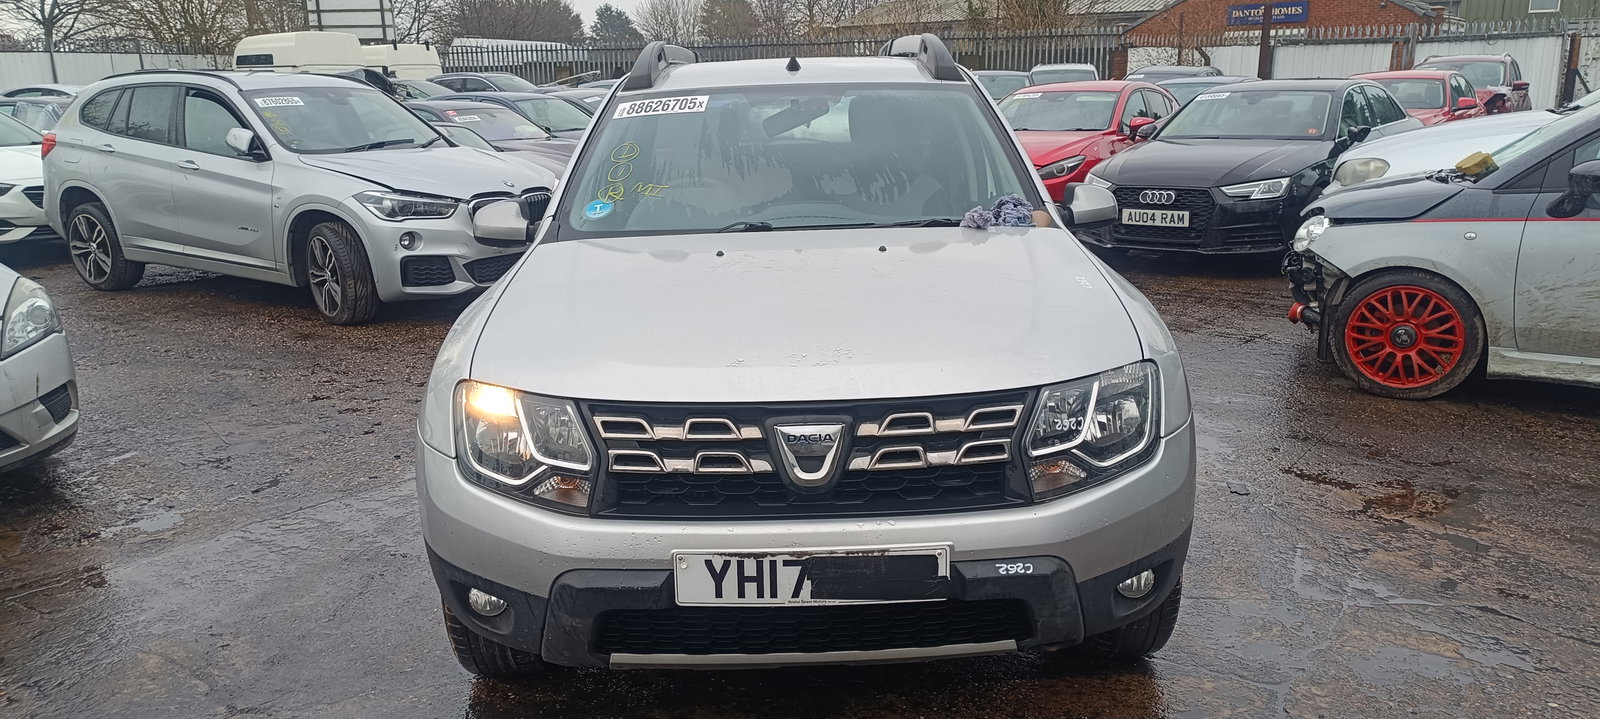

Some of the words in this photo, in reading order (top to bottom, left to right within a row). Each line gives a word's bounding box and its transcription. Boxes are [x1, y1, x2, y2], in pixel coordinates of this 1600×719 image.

[1272, 7, 1302, 15] HOMES
[1127, 211, 1156, 224] AU04
[1160, 213, 1185, 225] RAM
[787, 433, 834, 443] DACIA
[995, 562, 1034, 575] C262
[704, 559, 810, 599] YH17
